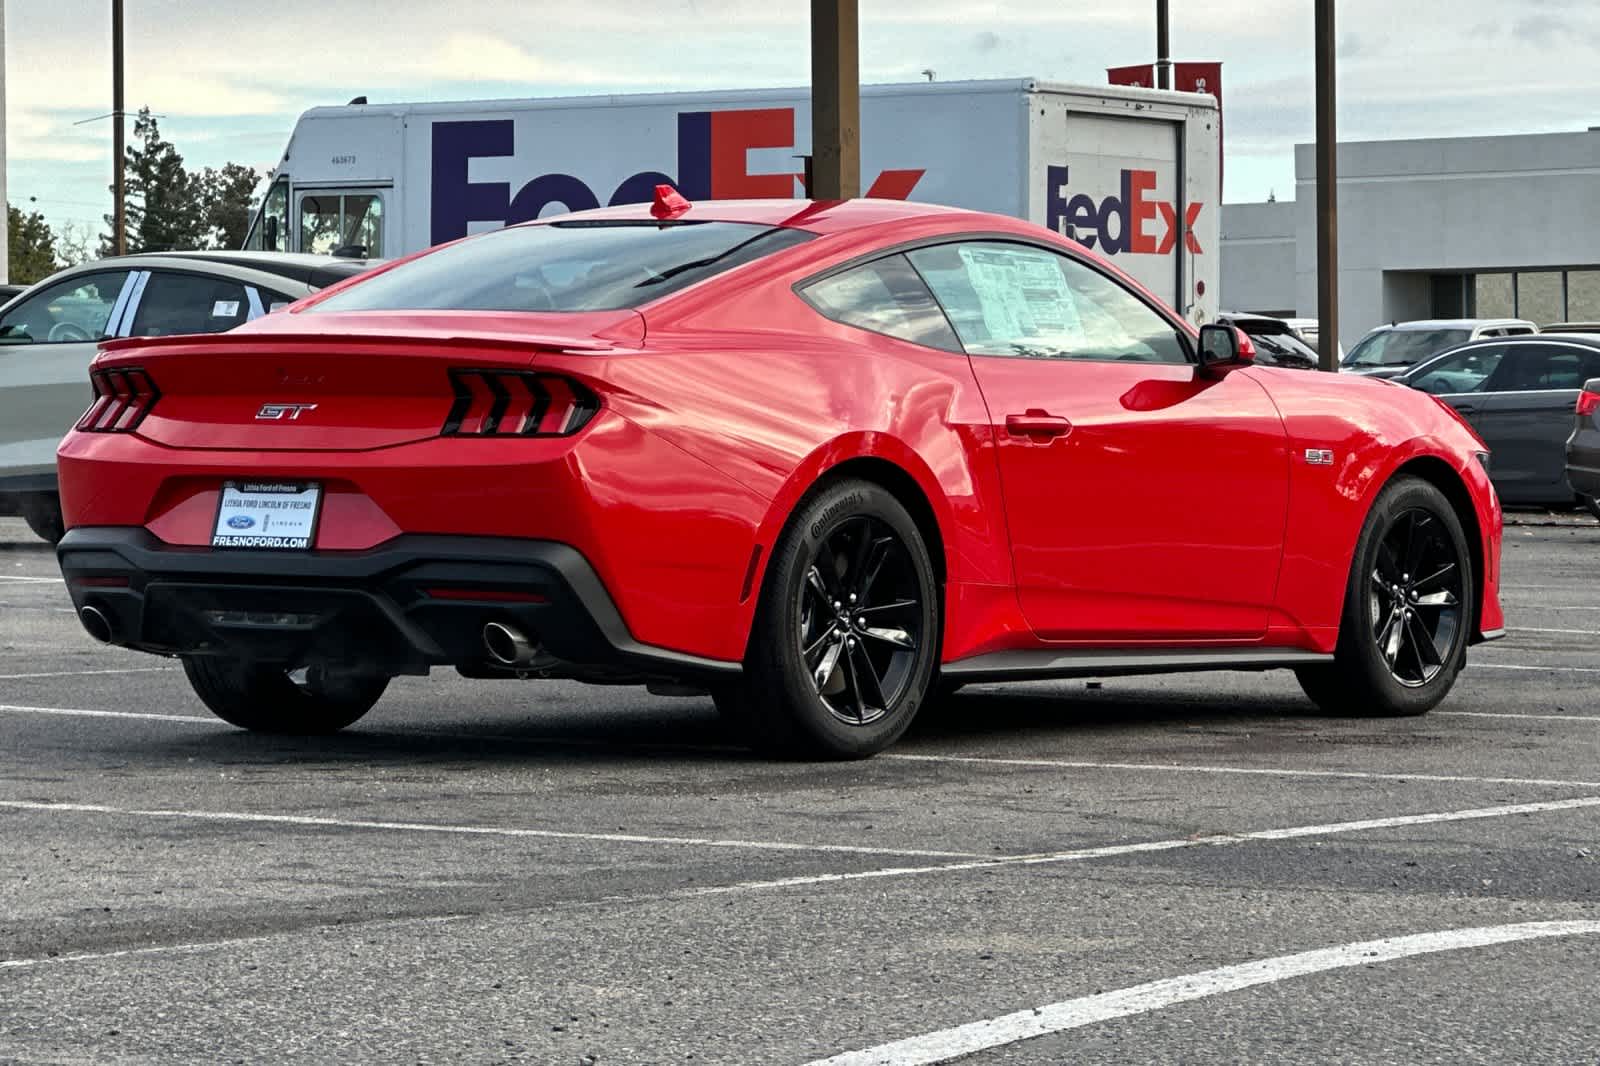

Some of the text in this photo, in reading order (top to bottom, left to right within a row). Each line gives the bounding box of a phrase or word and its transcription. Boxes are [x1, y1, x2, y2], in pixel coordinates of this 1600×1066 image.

[431, 107, 926, 247] FdE
[1047, 164, 1204, 256] FedEx
[255, 403, 318, 420] GT
[260, 484, 272, 492] Ford
[224, 499, 312, 509] LITHIA FORD LINCOLN OF FRESNO
[230, 516, 251, 528] Ford
